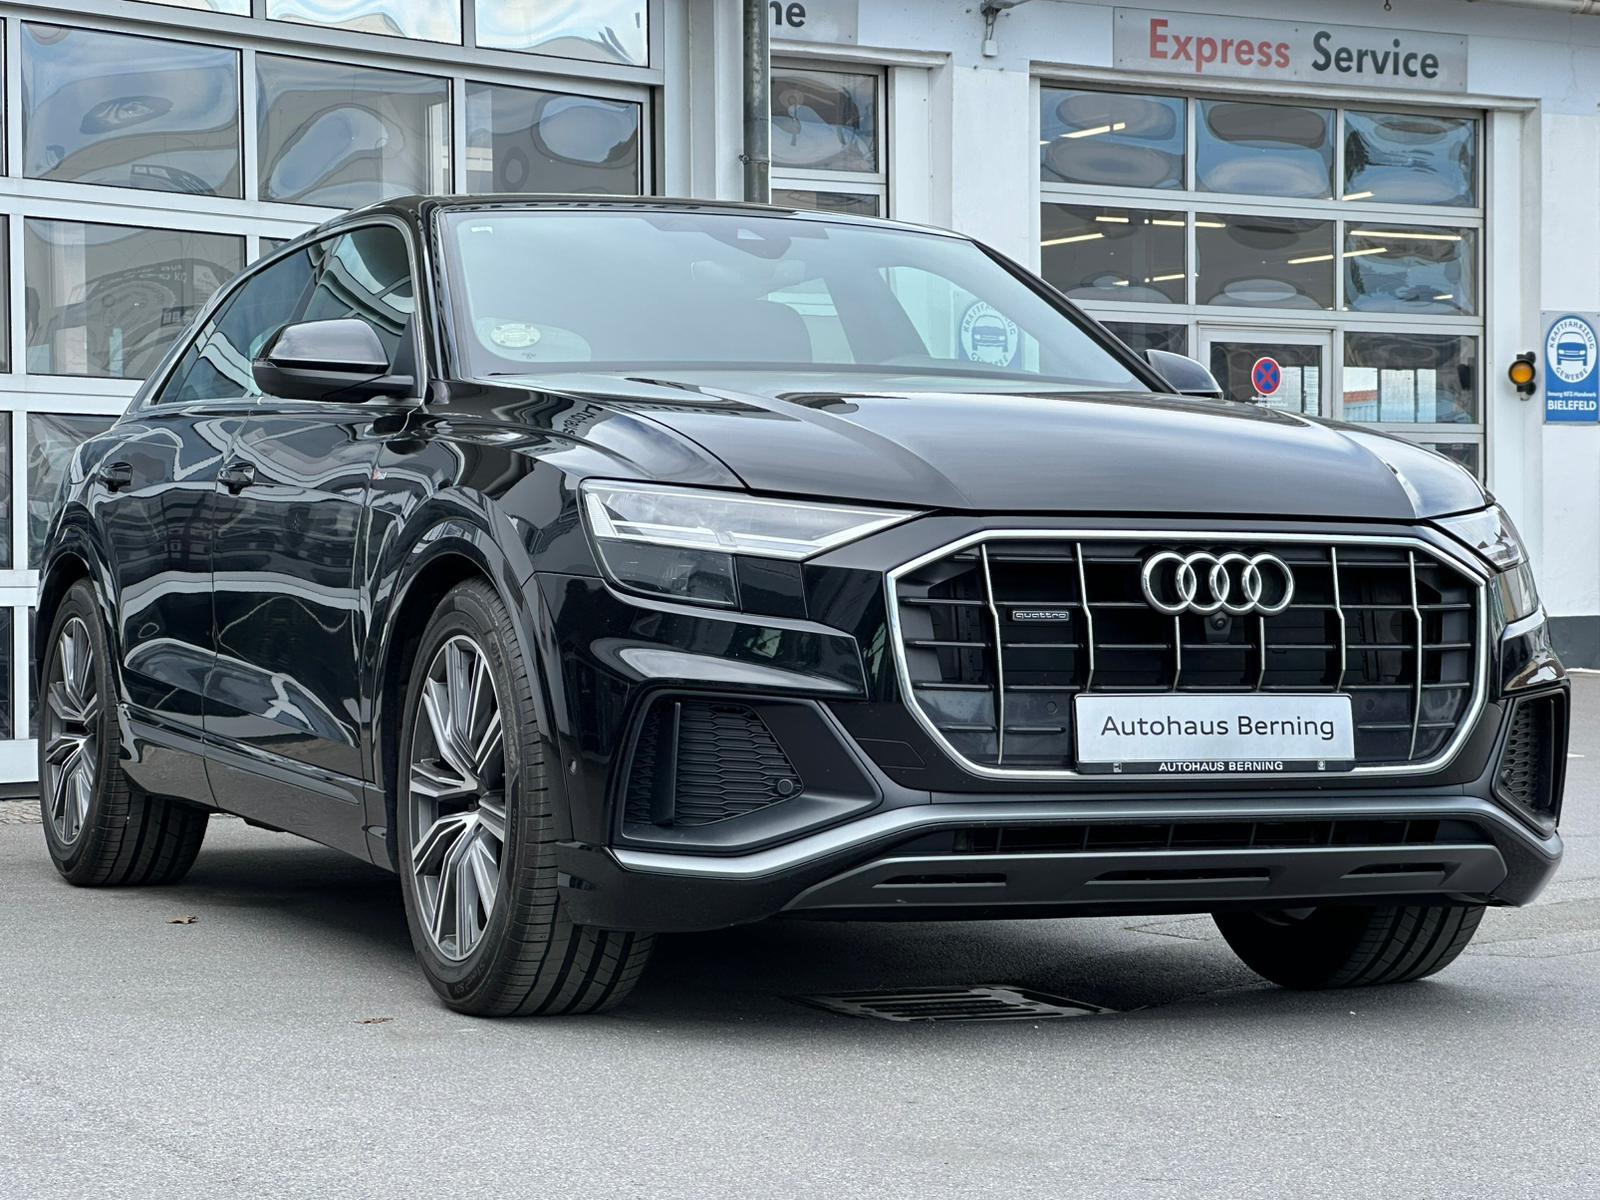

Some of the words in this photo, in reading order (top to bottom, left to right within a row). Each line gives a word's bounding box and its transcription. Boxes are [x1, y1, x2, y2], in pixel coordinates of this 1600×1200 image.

[1149, 18, 1291, 73] Express
[1311, 30, 1440, 80] Service
[1549, 320, 1595, 350] KRAFTFAHRZEUG
[1556, 366, 1588, 381] GEWERBE
[1547, 400, 1597, 411] BIELEFELD
[1100, 715, 1229, 736] Autohaus
[1237, 715, 1335, 741] Berning
[1158, 761, 1226, 772] AUTOHAUS
[1228, 761, 1284, 771] BERNING
